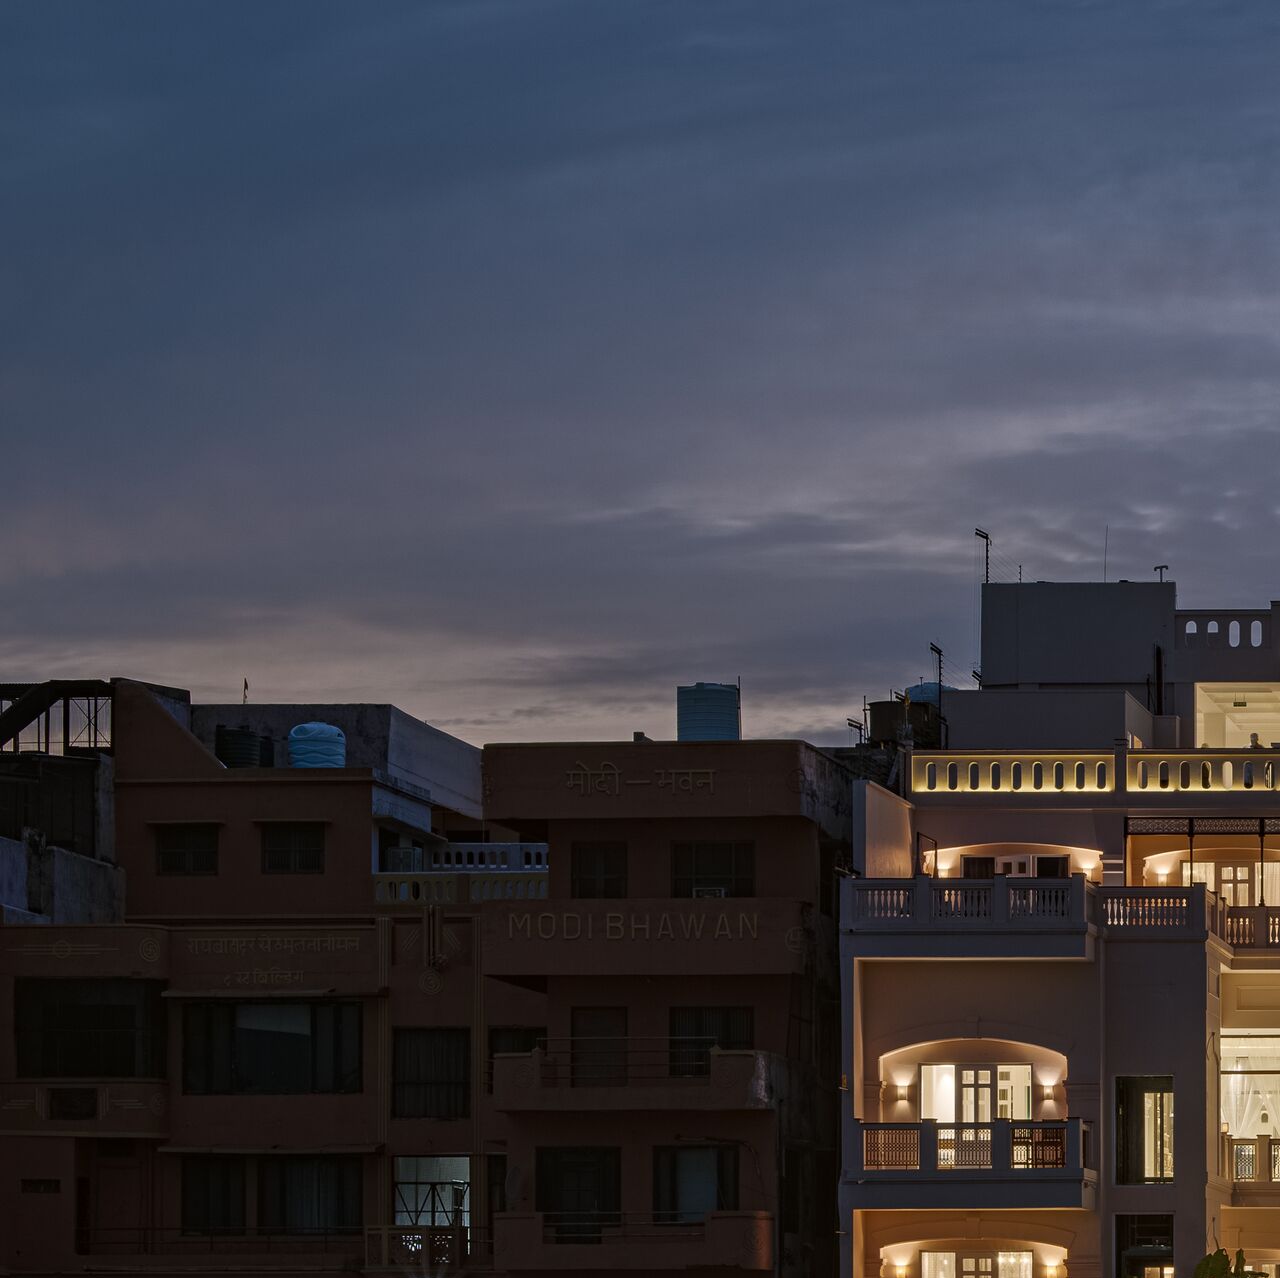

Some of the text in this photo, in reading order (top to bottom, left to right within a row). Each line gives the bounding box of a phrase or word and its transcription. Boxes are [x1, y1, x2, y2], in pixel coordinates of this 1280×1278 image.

[565, 760, 624, 796] मोदी
[654, 768, 717, 796] भवन
[507, 912, 760, 941] MODI BHAWAN
